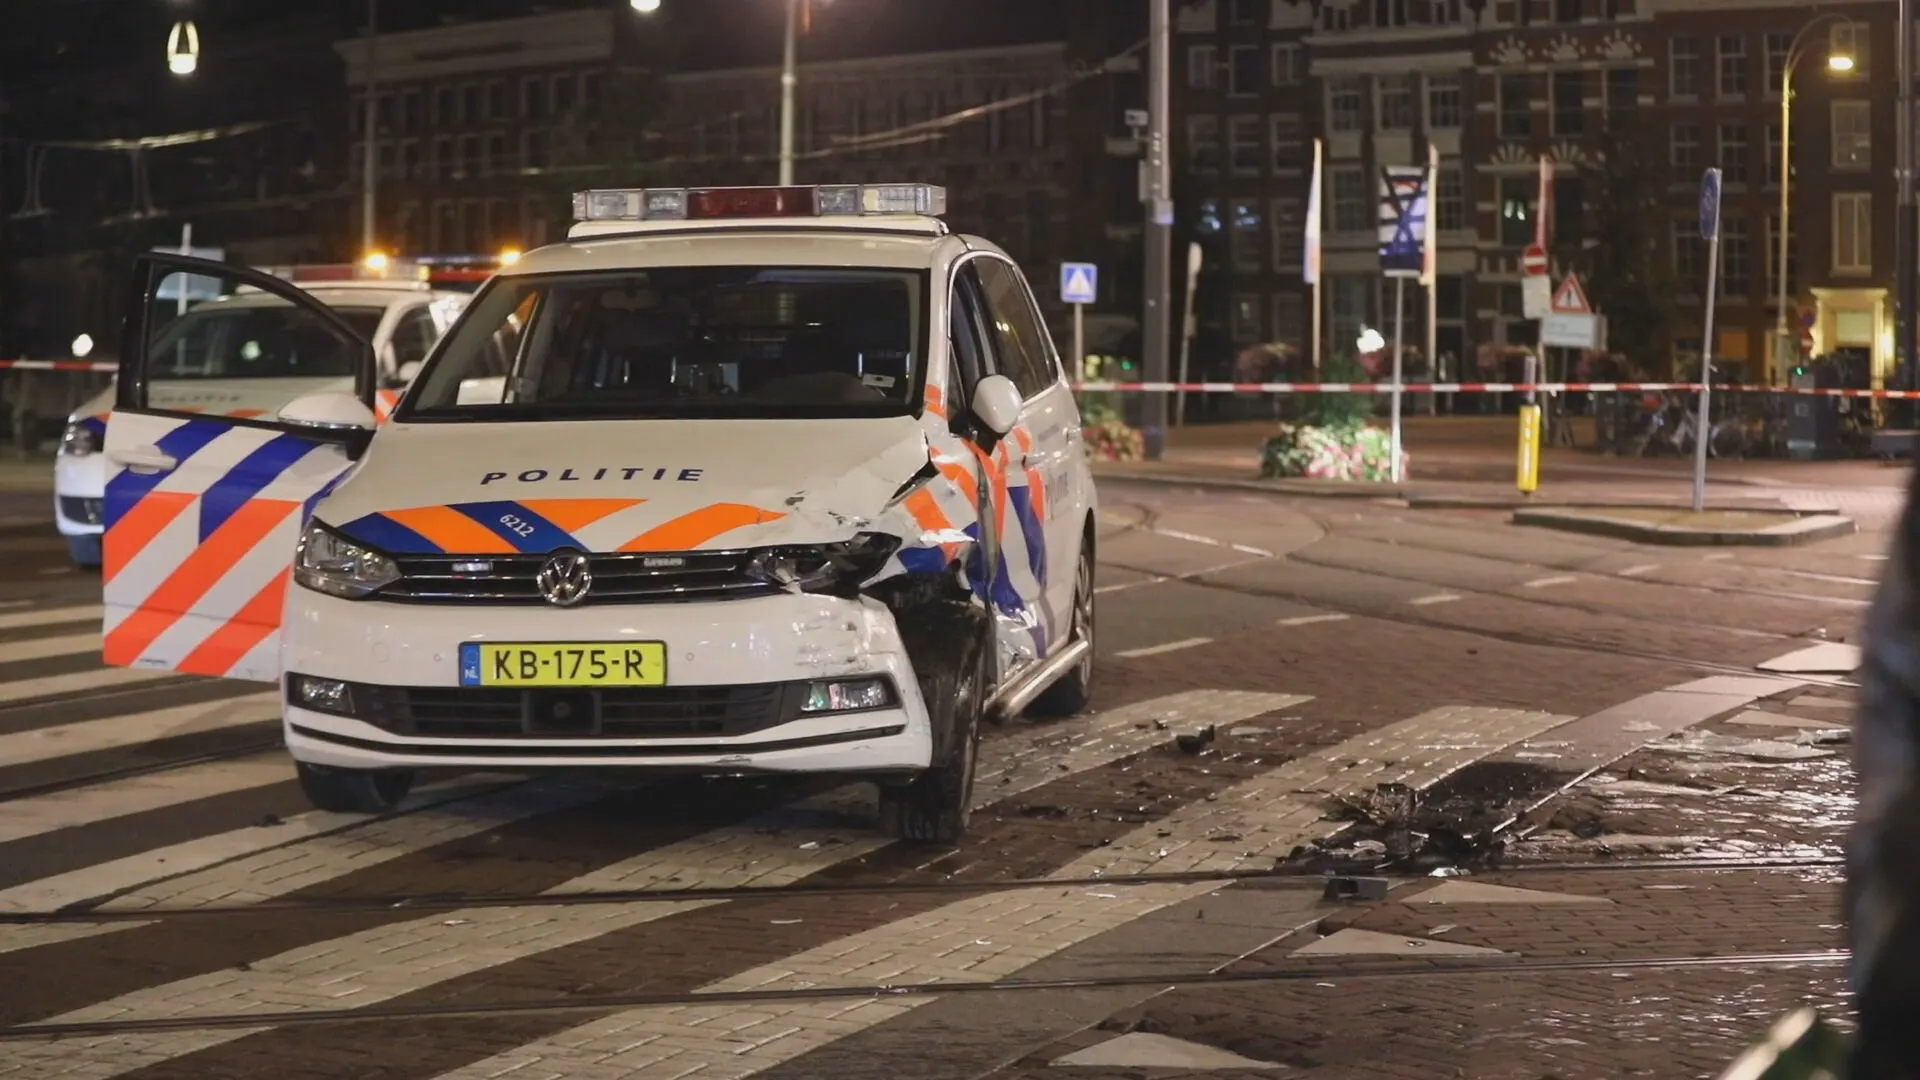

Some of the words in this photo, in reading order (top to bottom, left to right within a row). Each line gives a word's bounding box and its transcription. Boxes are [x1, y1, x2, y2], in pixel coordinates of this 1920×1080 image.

[480, 468, 704, 485] POLITIE
[500, 514, 535, 537] 6212
[495, 649, 645, 680] KB-175-R
